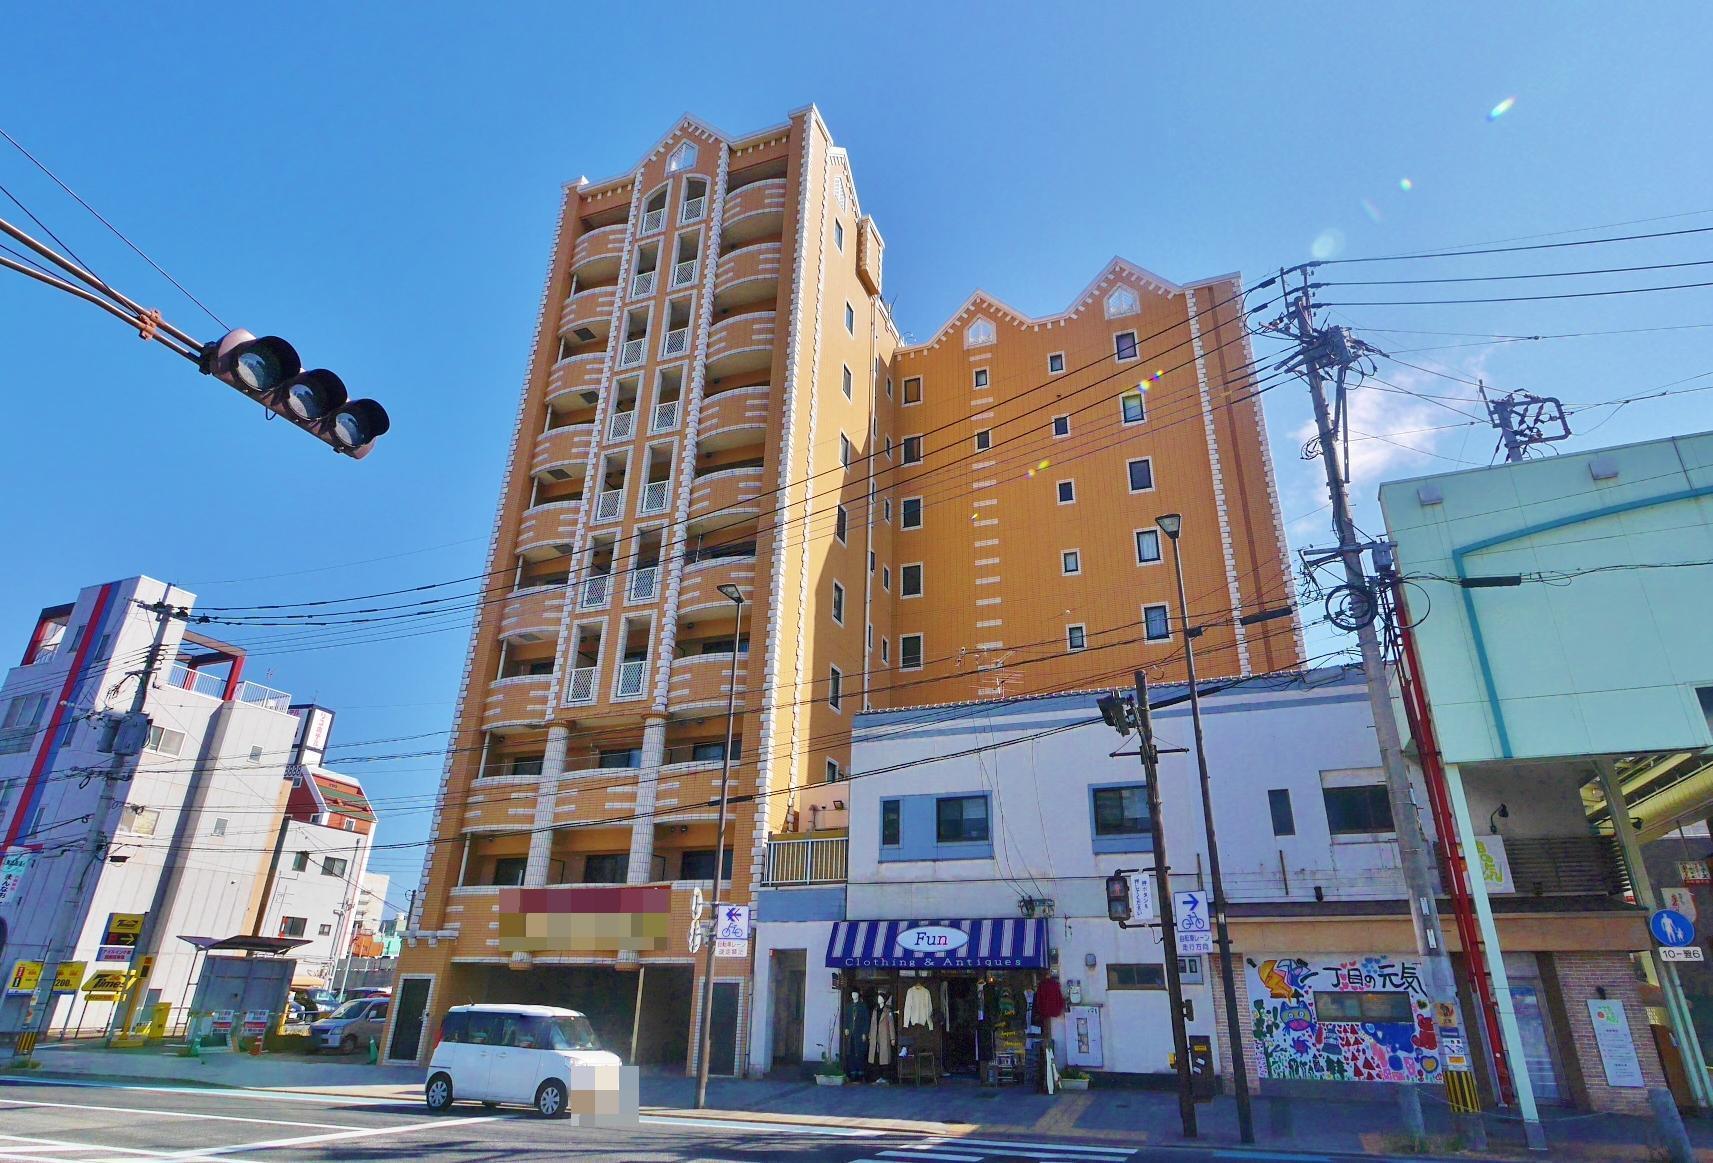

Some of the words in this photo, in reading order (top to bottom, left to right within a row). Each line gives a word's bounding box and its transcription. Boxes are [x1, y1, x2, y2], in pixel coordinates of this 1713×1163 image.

[914, 932, 949, 946] Fun
[1179, 934, 1210, 943] 自転車レーン
[1182, 943, 1209, 951] 走行方向
[845, 958, 915, 968] Clothing
[924, 958, 935, 966] &
[943, 958, 1022, 967] Antiques
